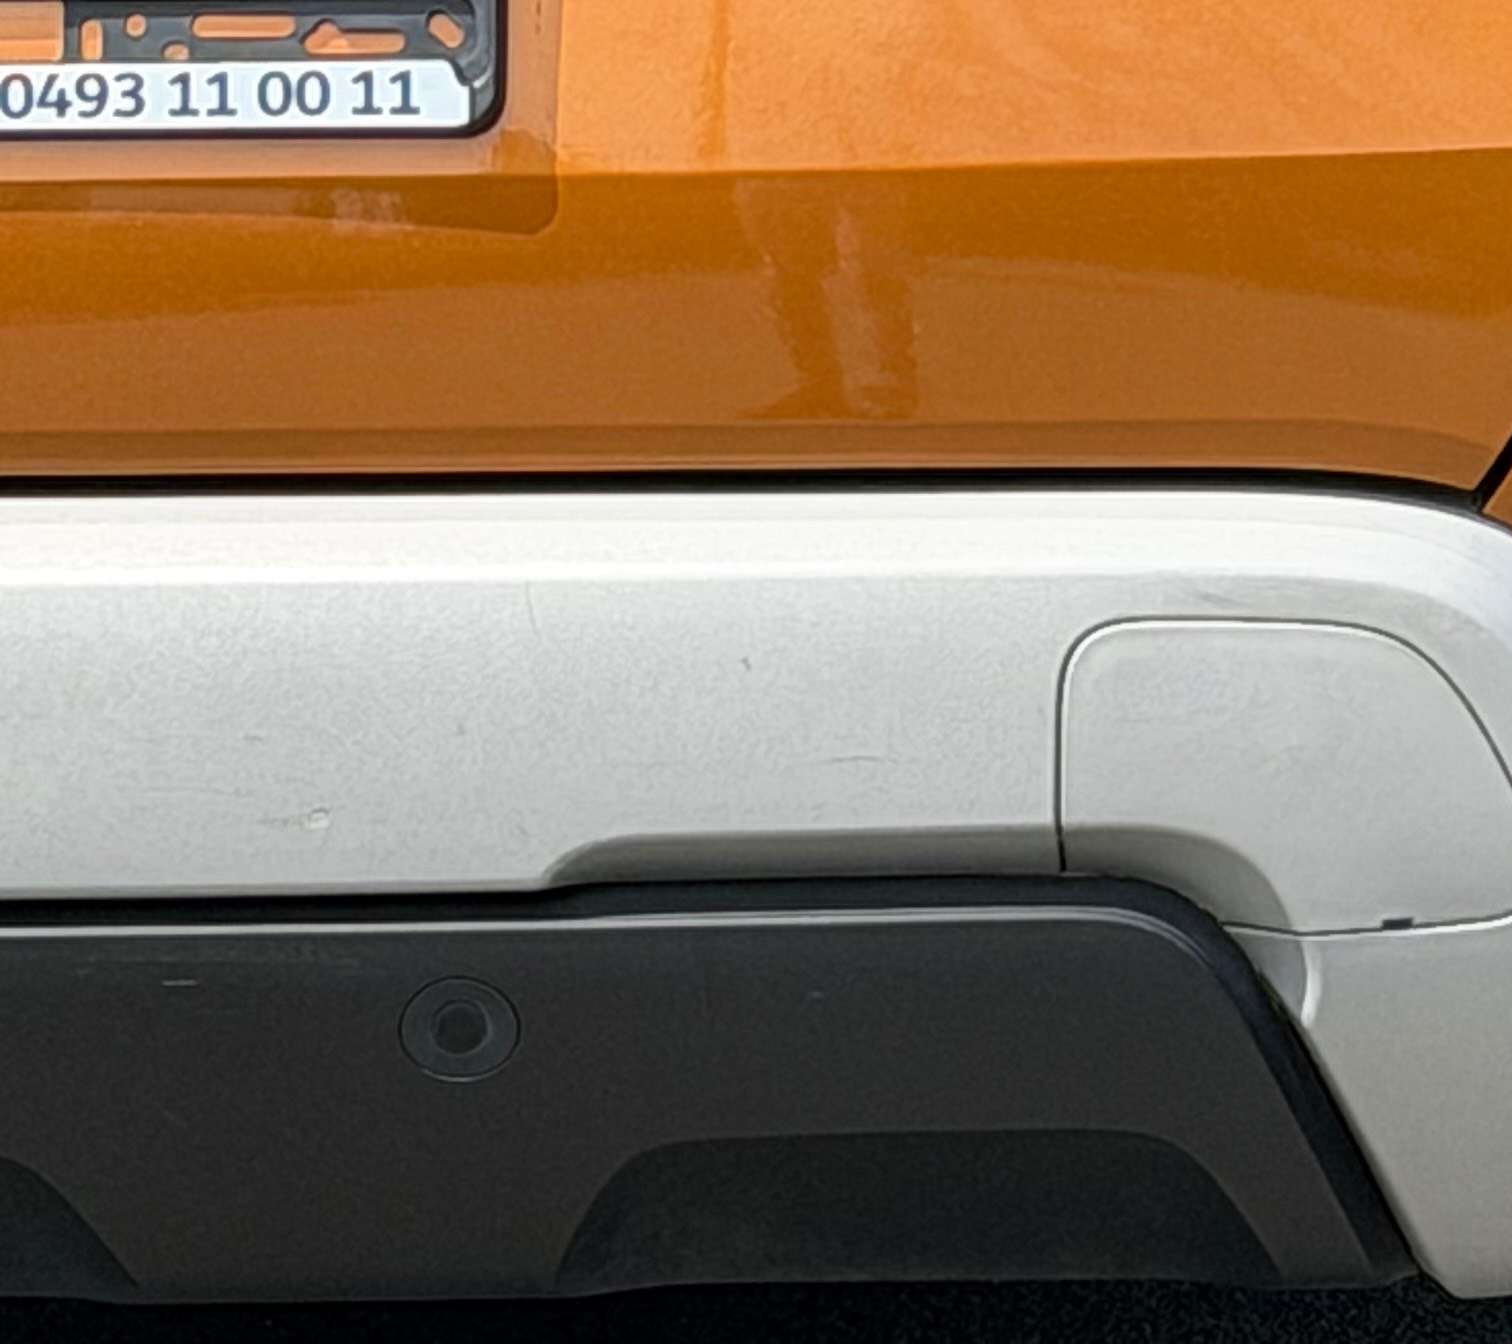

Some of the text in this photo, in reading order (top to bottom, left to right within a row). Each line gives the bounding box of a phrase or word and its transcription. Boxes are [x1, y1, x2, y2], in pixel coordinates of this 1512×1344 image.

[0, 70, 420, 120] 0493 11 00 11
